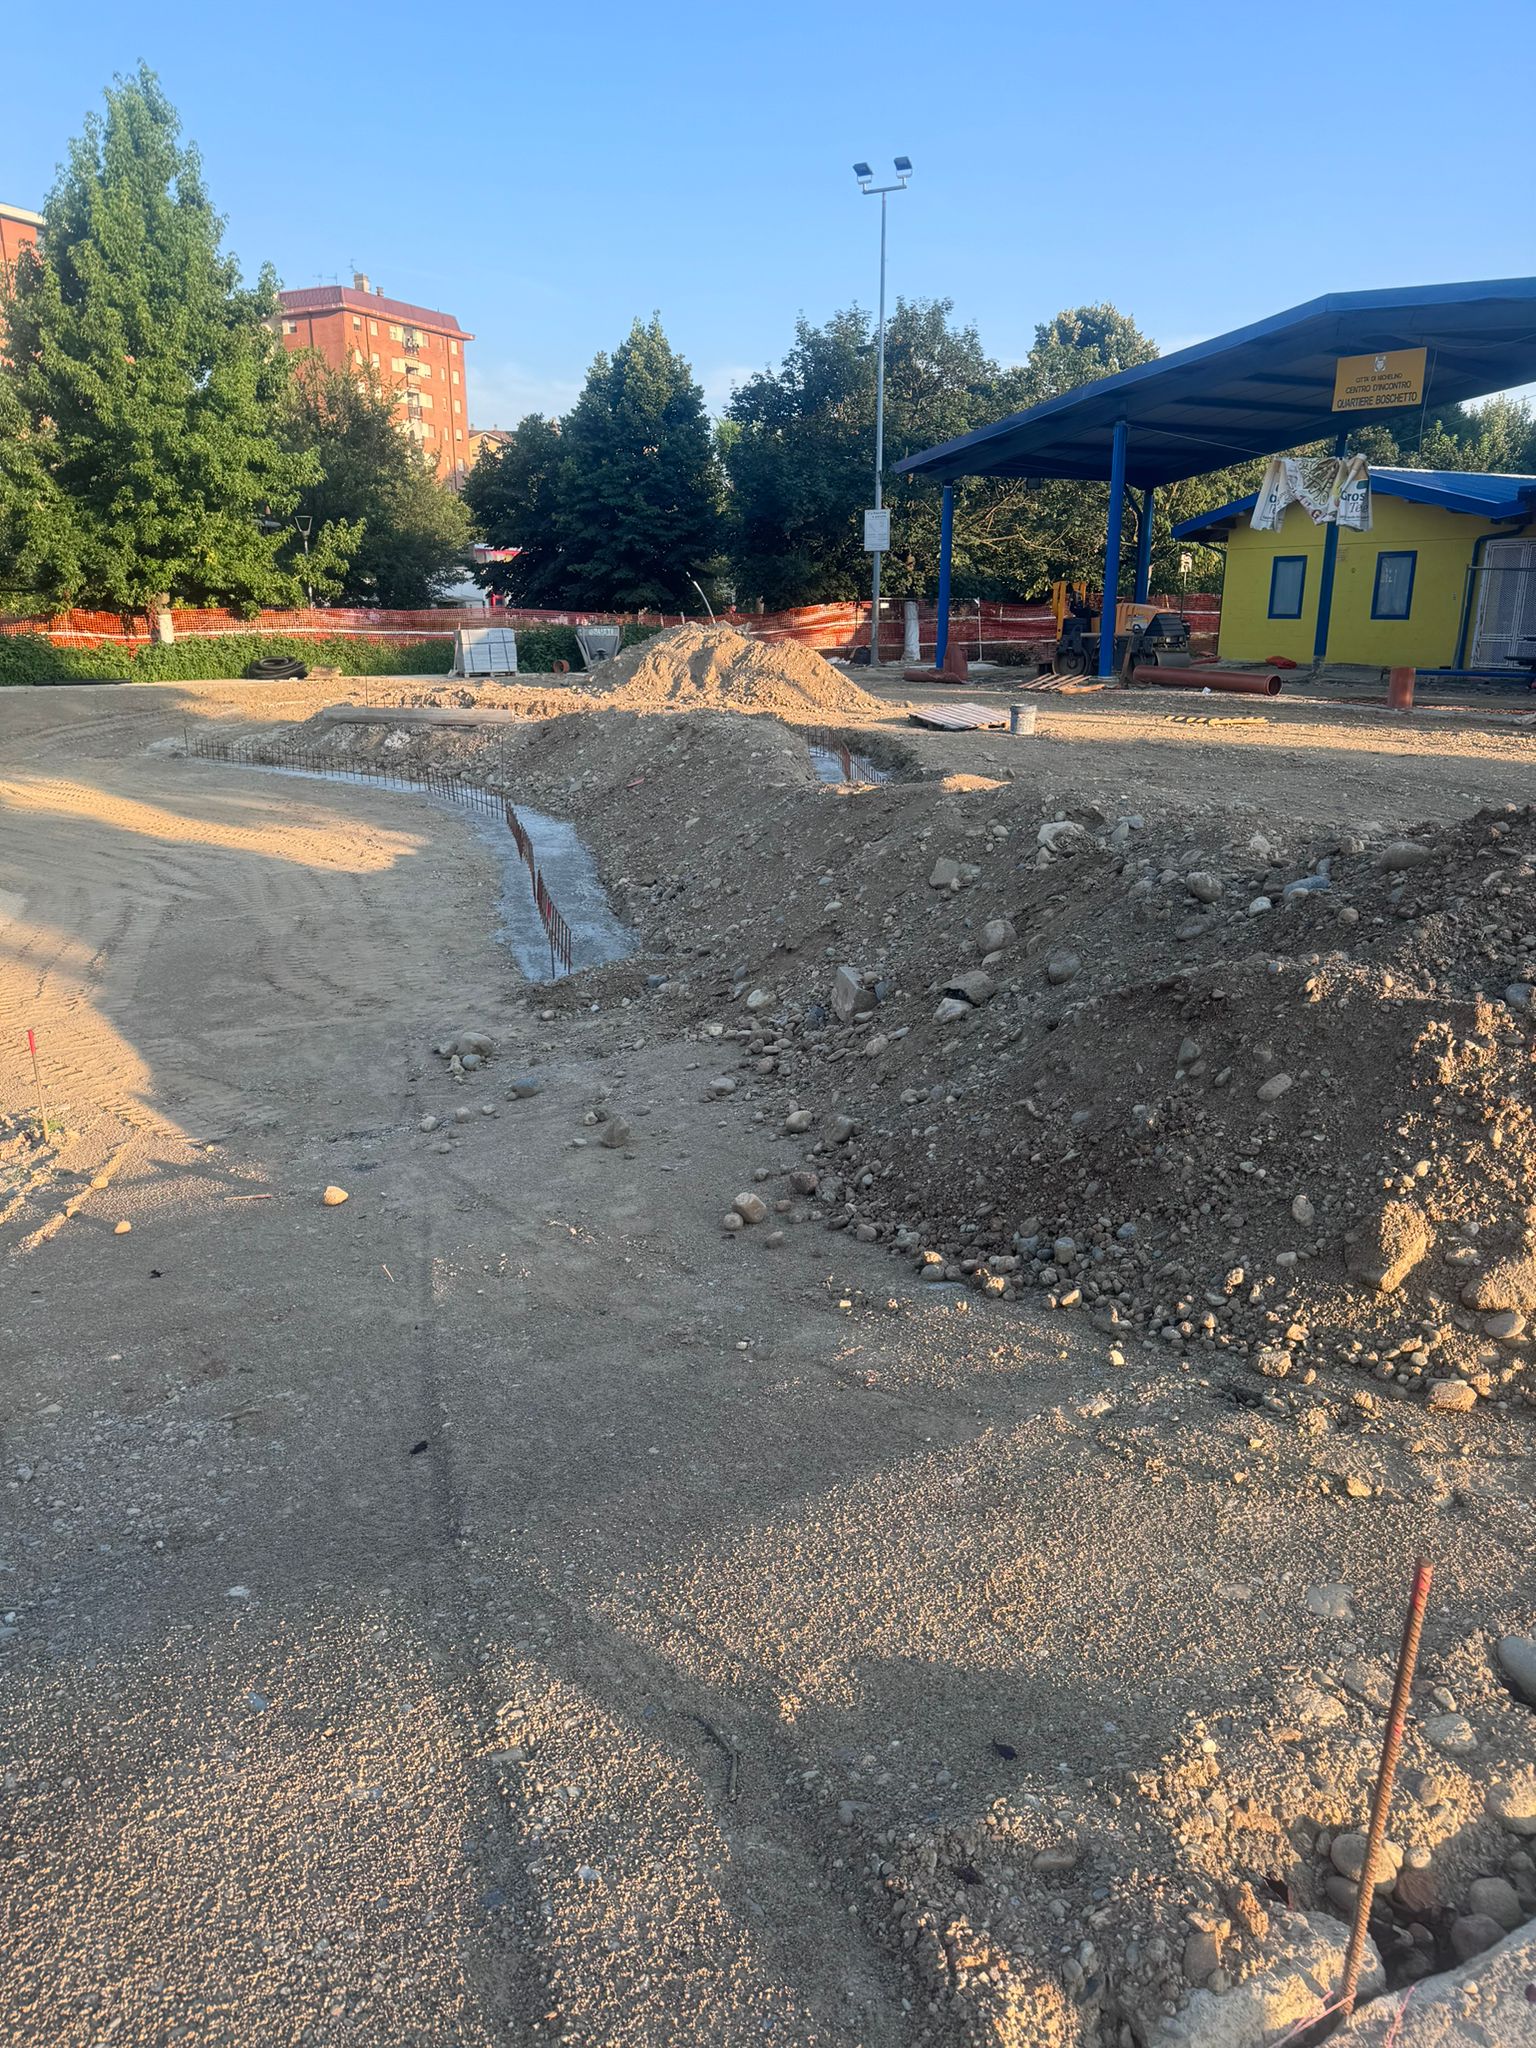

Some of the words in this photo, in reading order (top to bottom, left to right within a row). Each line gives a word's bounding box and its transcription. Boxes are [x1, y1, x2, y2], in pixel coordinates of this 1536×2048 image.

[1345, 384, 1371, 394] CENTRO
[1336, 395, 1374, 408] QUARTIERE
[1375, 391, 1418, 405] BOSCHETTO
